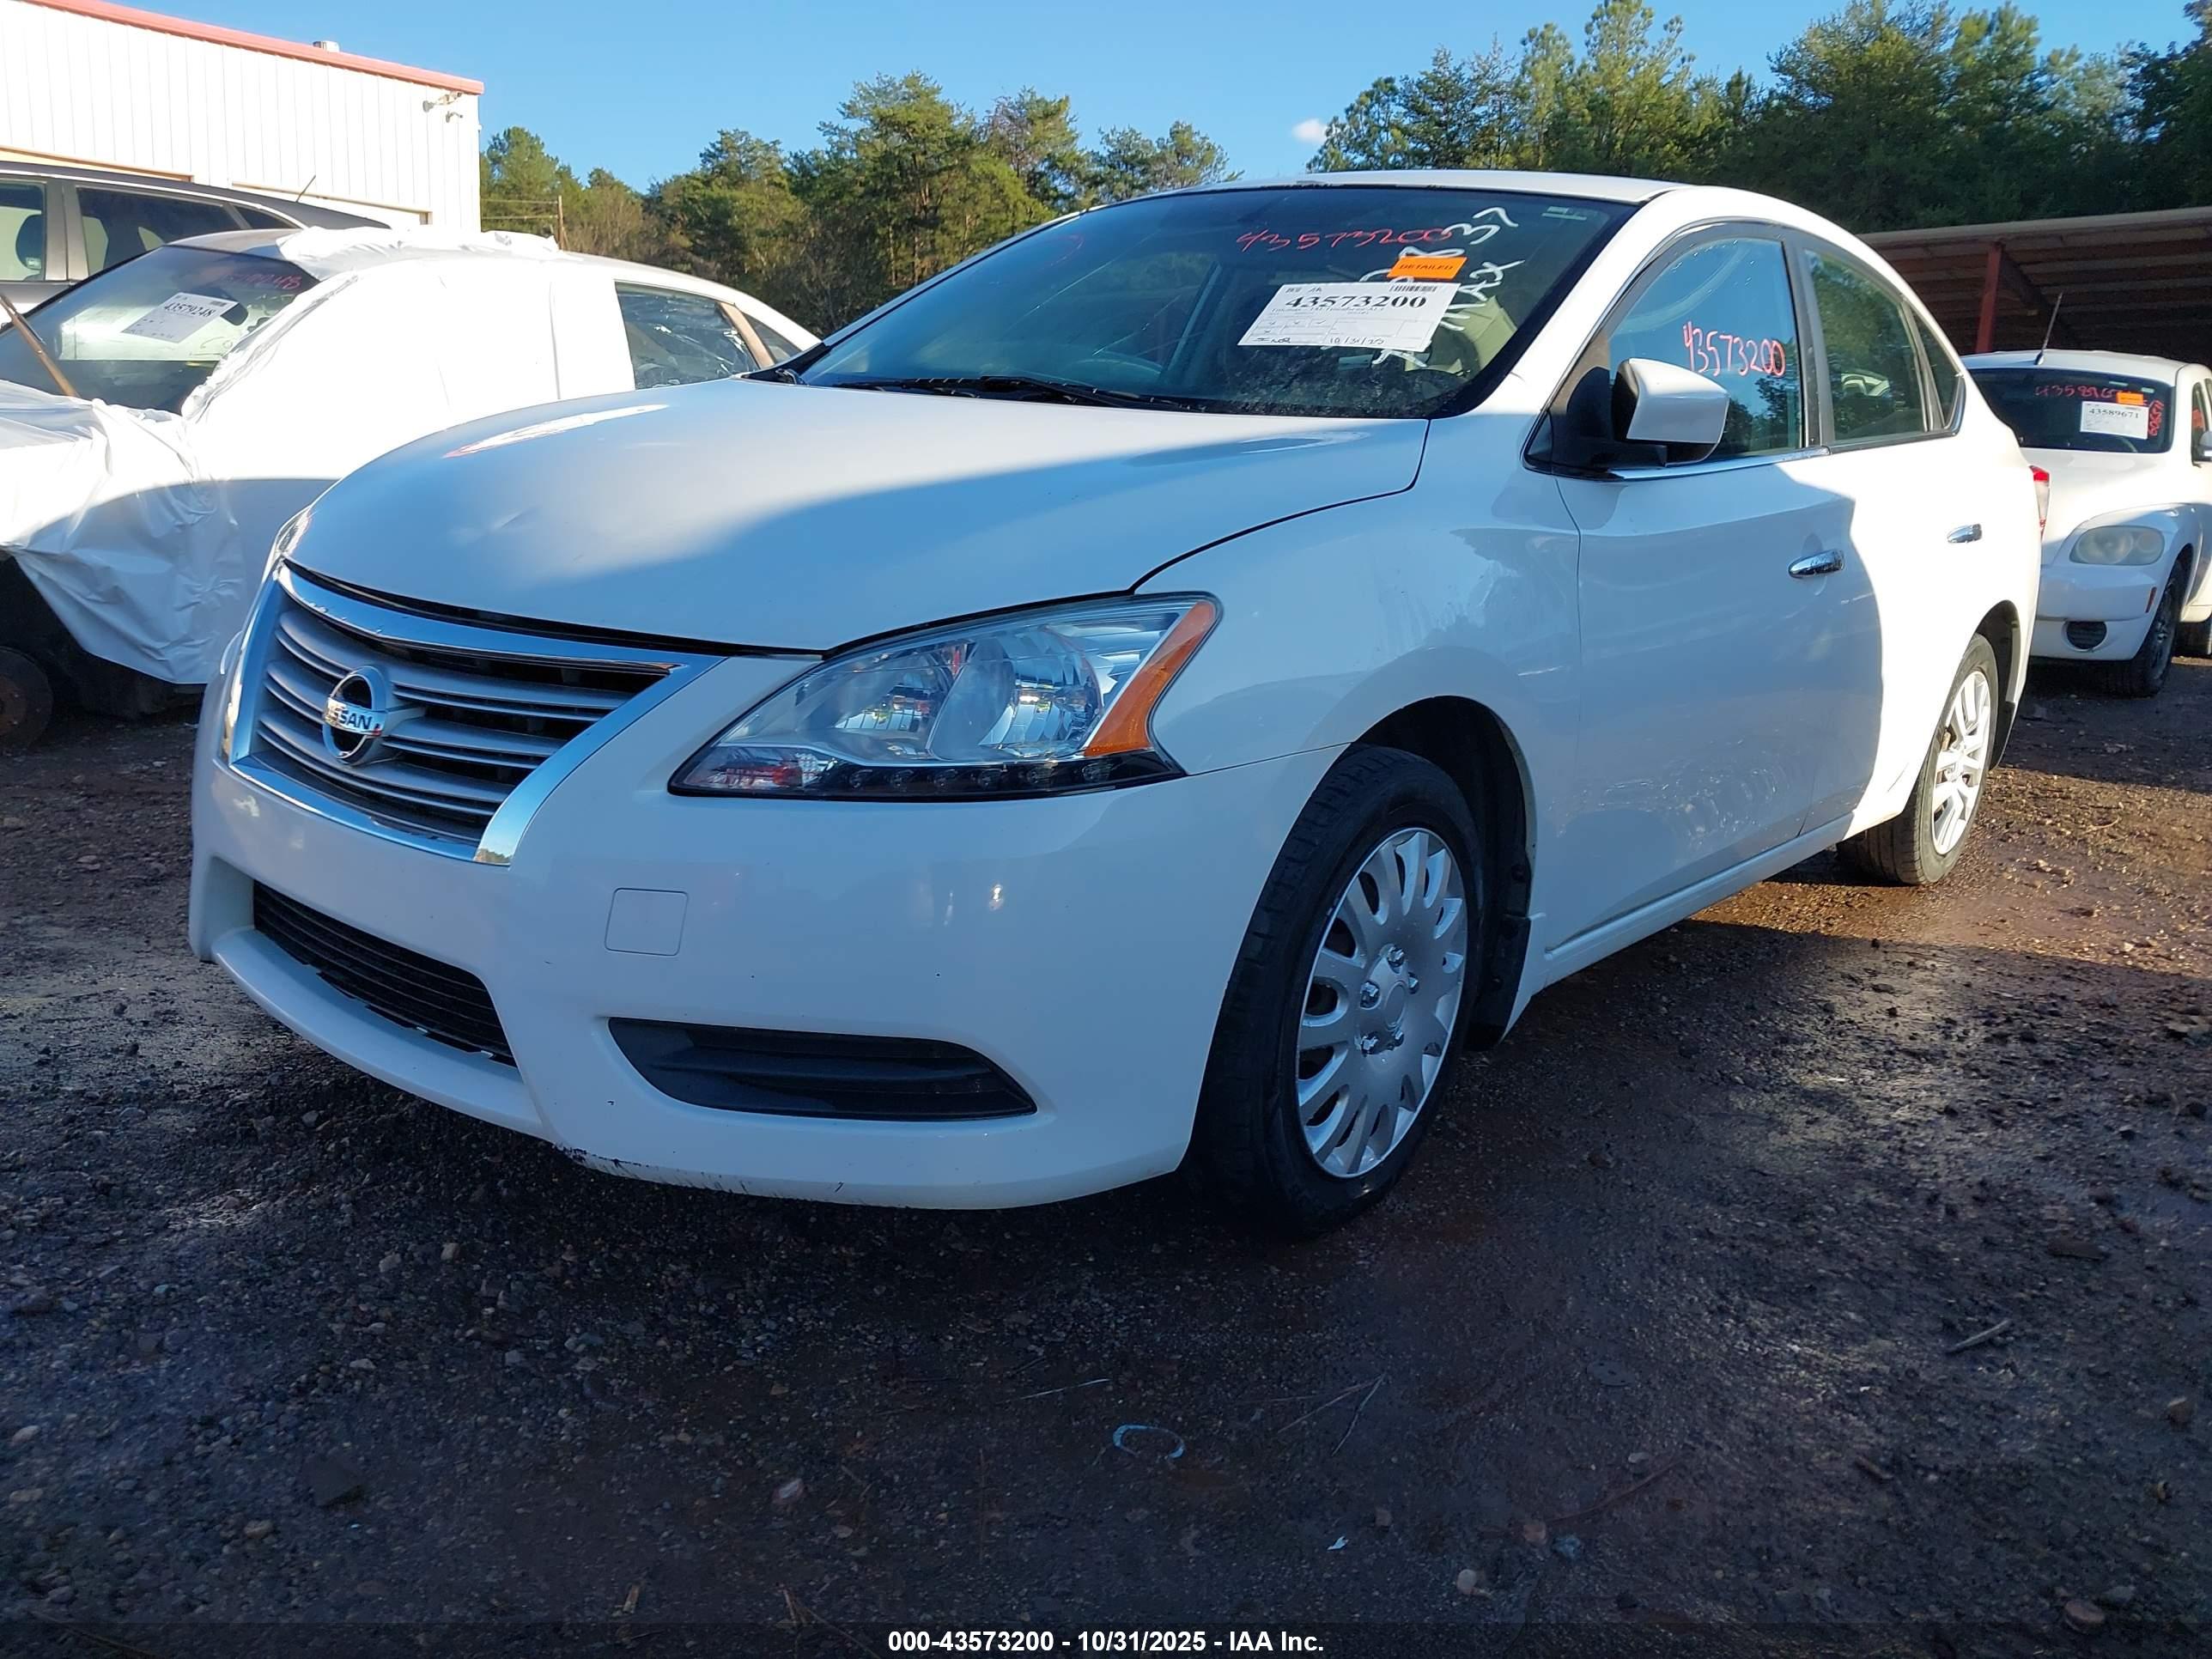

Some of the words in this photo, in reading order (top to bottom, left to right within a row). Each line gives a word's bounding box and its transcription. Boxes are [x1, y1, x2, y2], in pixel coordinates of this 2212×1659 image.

[1237, 227, 1454, 252] 43573200
[1285, 295, 1427, 310] 43573200
[1682, 320, 1786, 376] 43573200
[2034, 385, 2123, 399] 435896
[2088, 408, 2139, 419] 43589671
